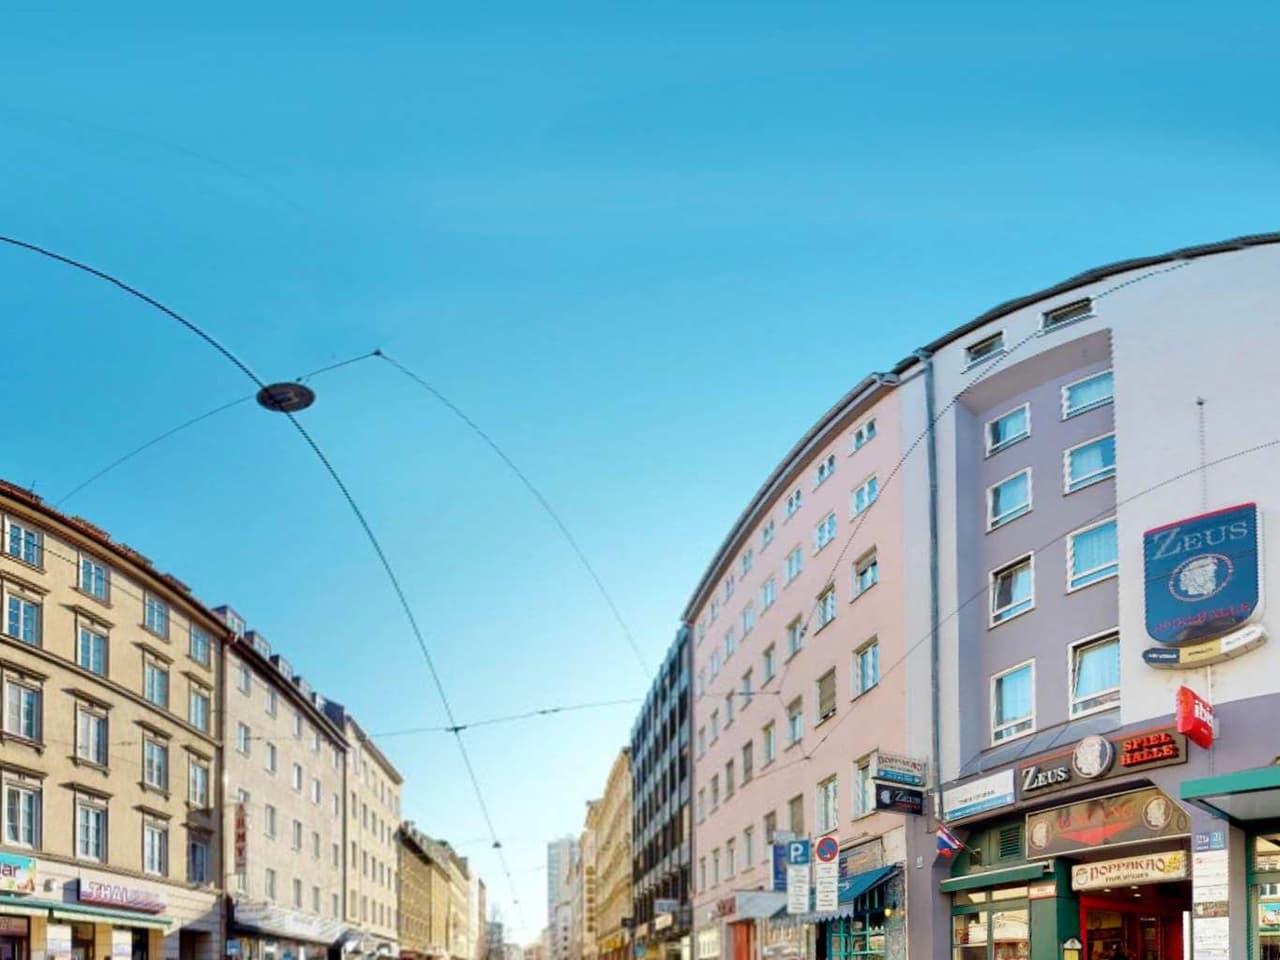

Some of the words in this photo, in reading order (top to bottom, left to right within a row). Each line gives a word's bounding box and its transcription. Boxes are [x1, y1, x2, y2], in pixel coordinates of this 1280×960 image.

[1152, 521, 1249, 560] ZEUS
[1122, 733, 1172, 751] SPIEL
[1120, 744, 1176, 767] HALLE
[1022, 766, 1068, 791] ZEUS
[791, 843, 804, 863] P
